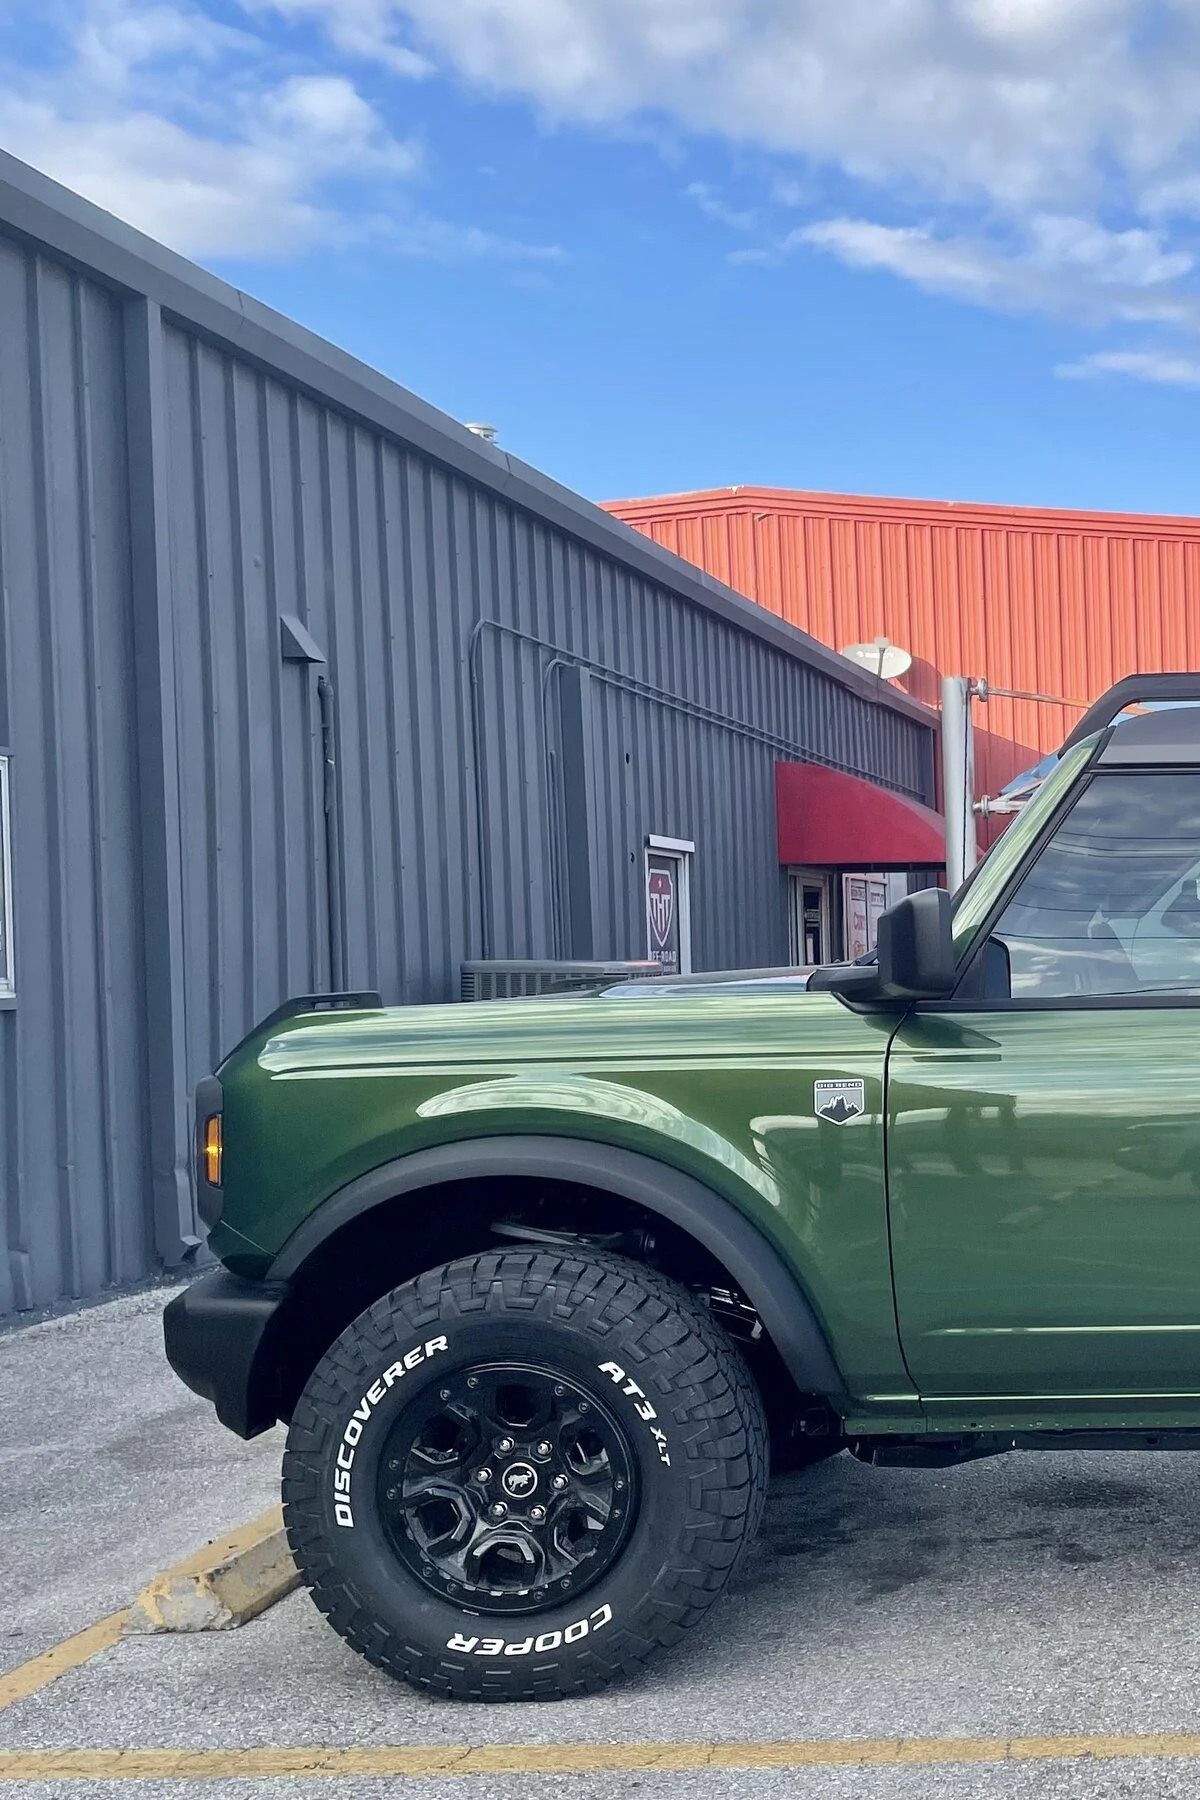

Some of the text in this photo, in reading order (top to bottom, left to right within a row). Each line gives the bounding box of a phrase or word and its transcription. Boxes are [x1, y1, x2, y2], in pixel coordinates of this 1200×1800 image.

[650, 950, 676, 962] FF-ROAD
[334, 1335, 449, 1528] DISCOVERER
[597, 1361, 671, 1467] AT3 XLT
[446, 1603, 613, 1656] COOPER
